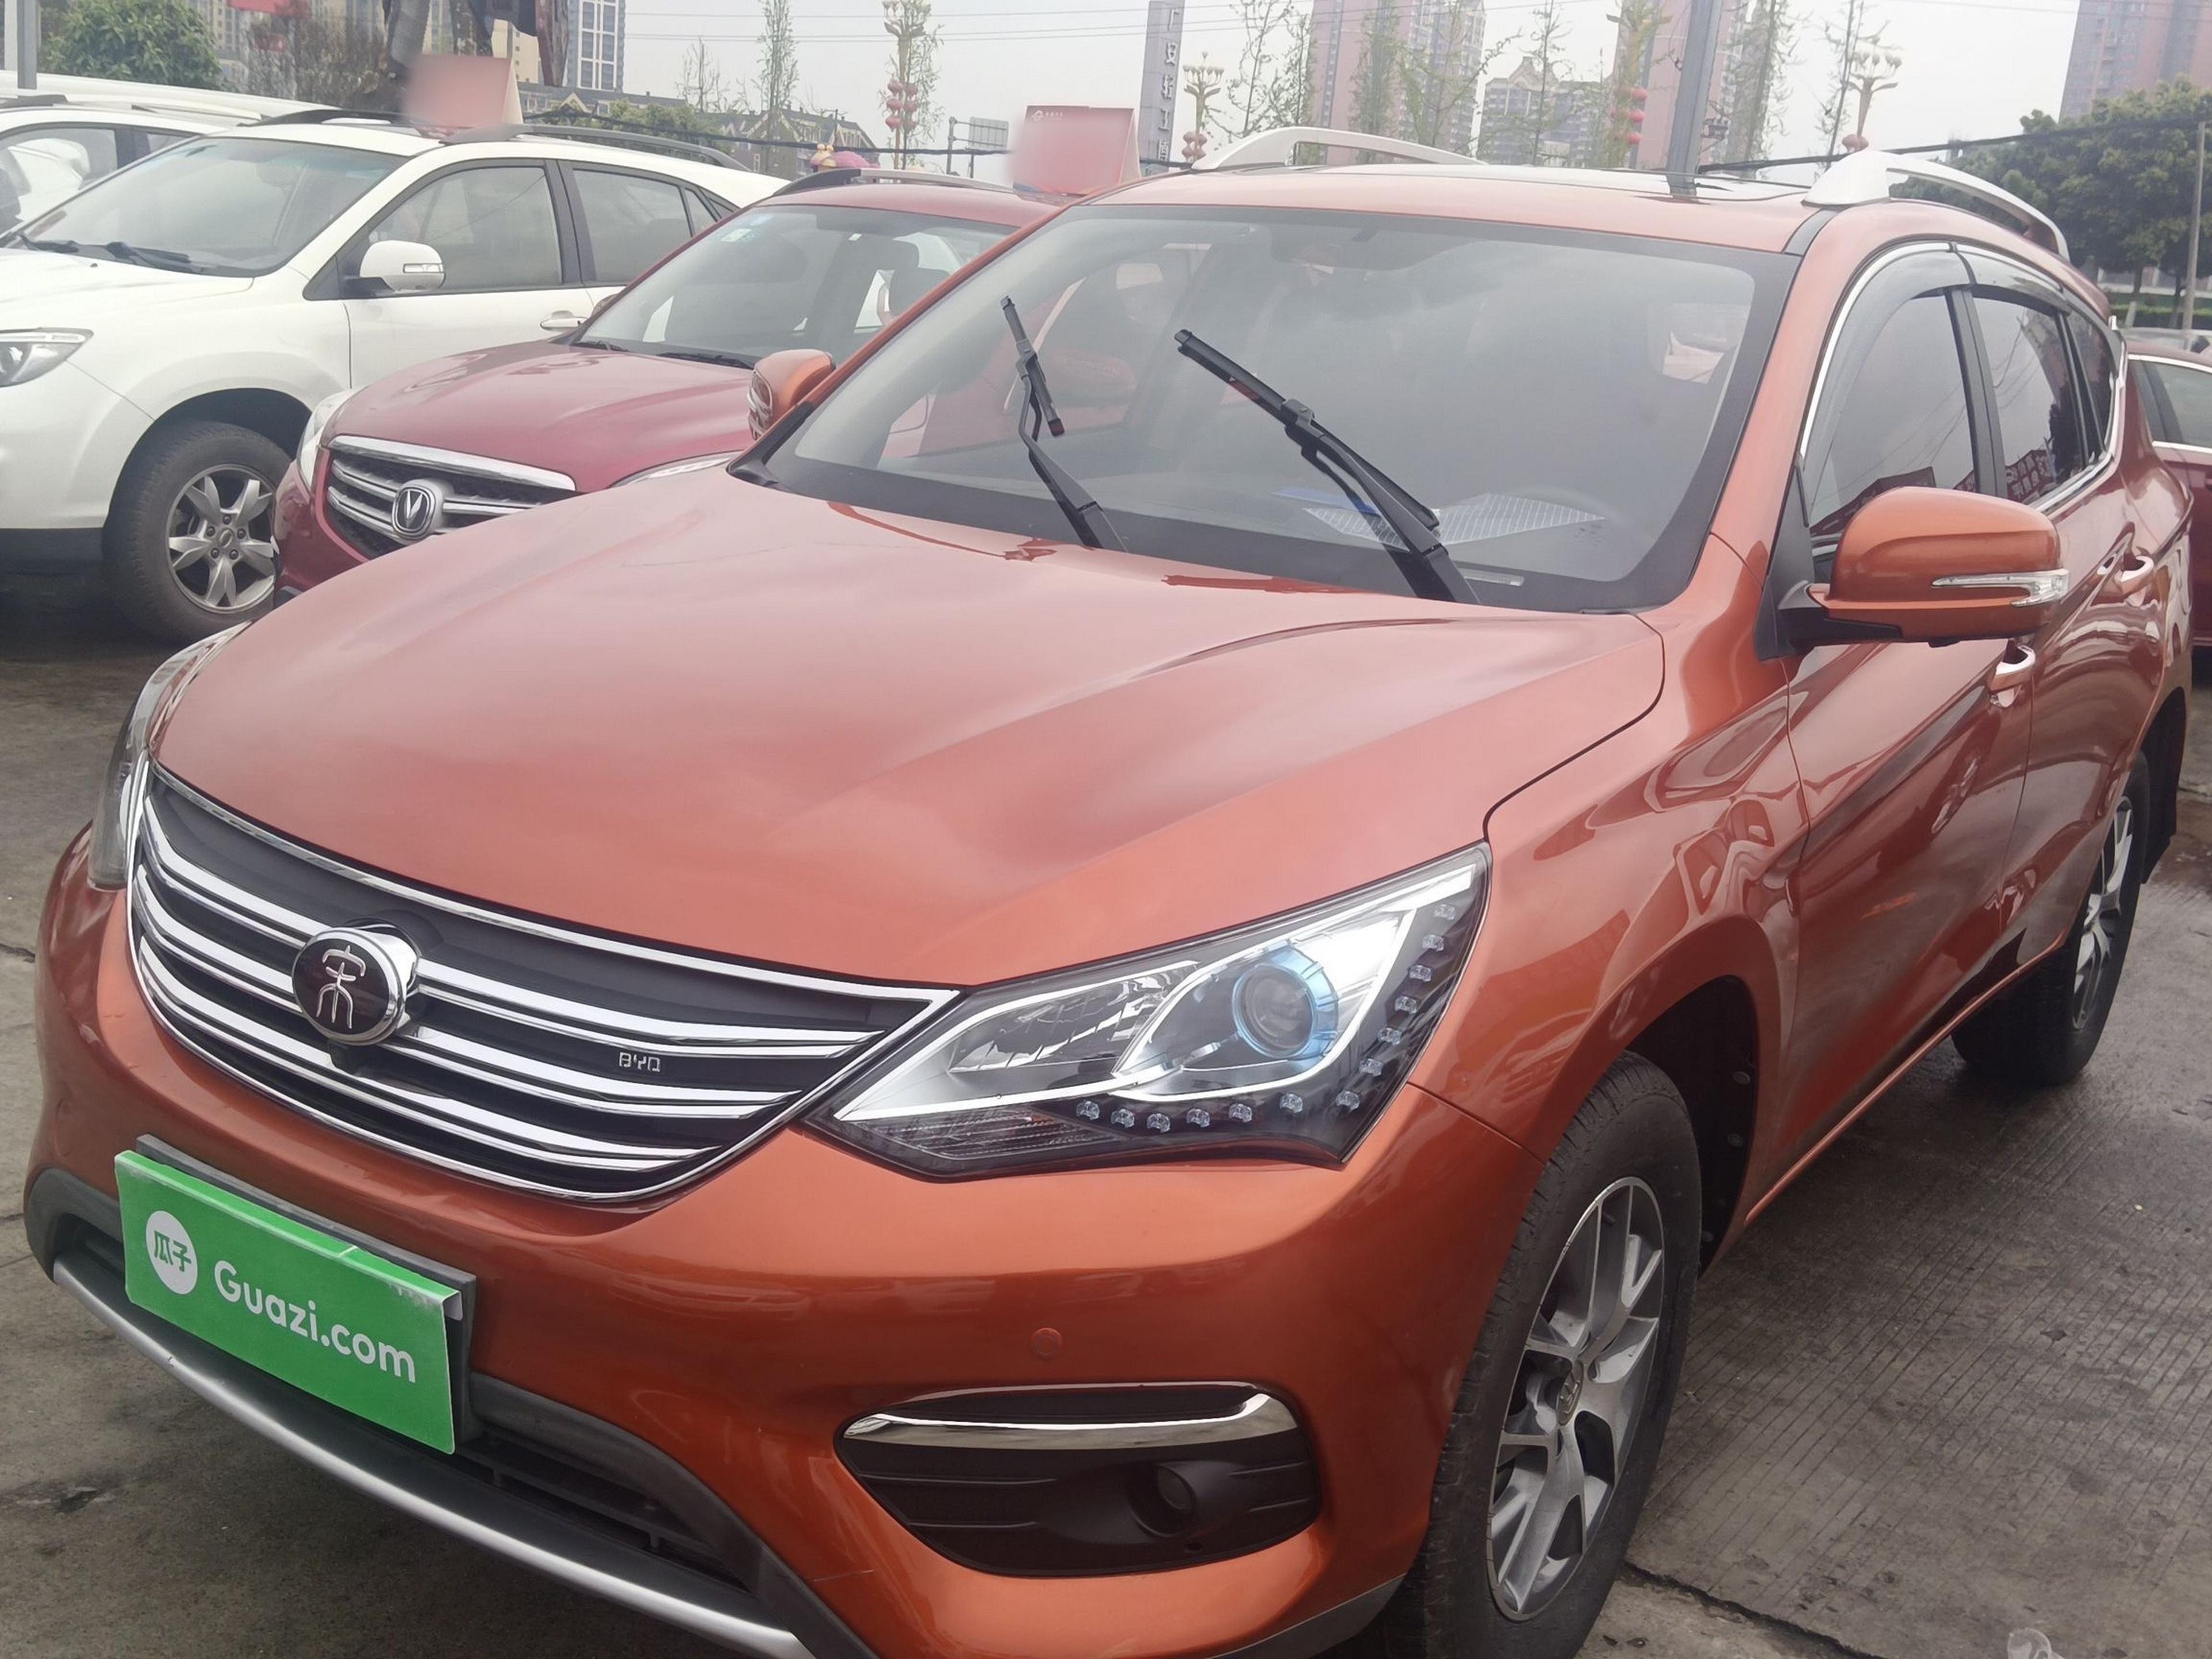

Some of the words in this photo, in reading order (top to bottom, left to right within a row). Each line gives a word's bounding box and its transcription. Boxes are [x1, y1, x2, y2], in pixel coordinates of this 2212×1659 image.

[619, 1052, 661, 1072] BYD
[154, 1230, 192, 1272] 瓜子
[214, 1260, 416, 1383] Guazi.com
